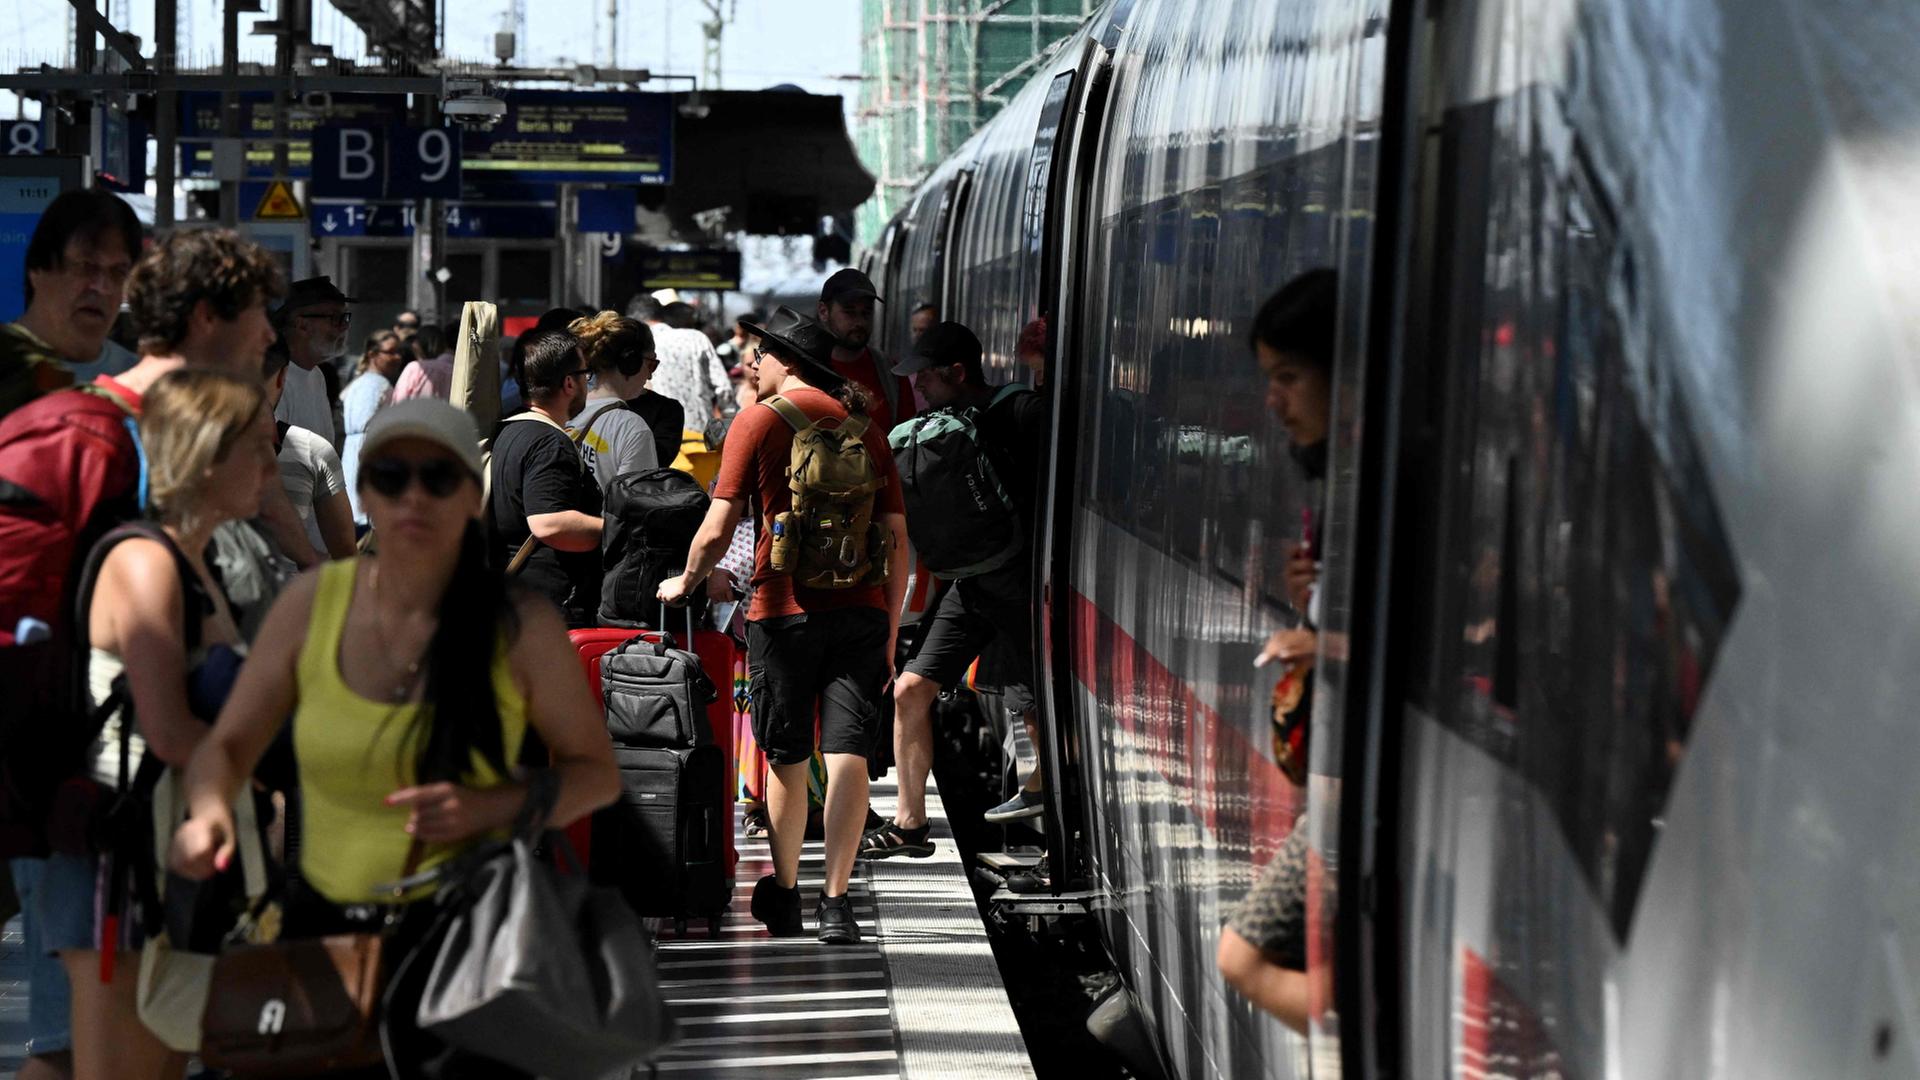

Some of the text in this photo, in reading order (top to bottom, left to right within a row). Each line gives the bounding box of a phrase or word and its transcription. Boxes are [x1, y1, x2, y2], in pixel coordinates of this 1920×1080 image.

[516, 120, 550, 133] Berlin
[338, 128, 376, 181] B
[417, 128, 452, 183] 9
[20, 188, 48, 198] 11:11
[344, 206, 379, 228] 1-7
[0, 230, 26, 245] ain
